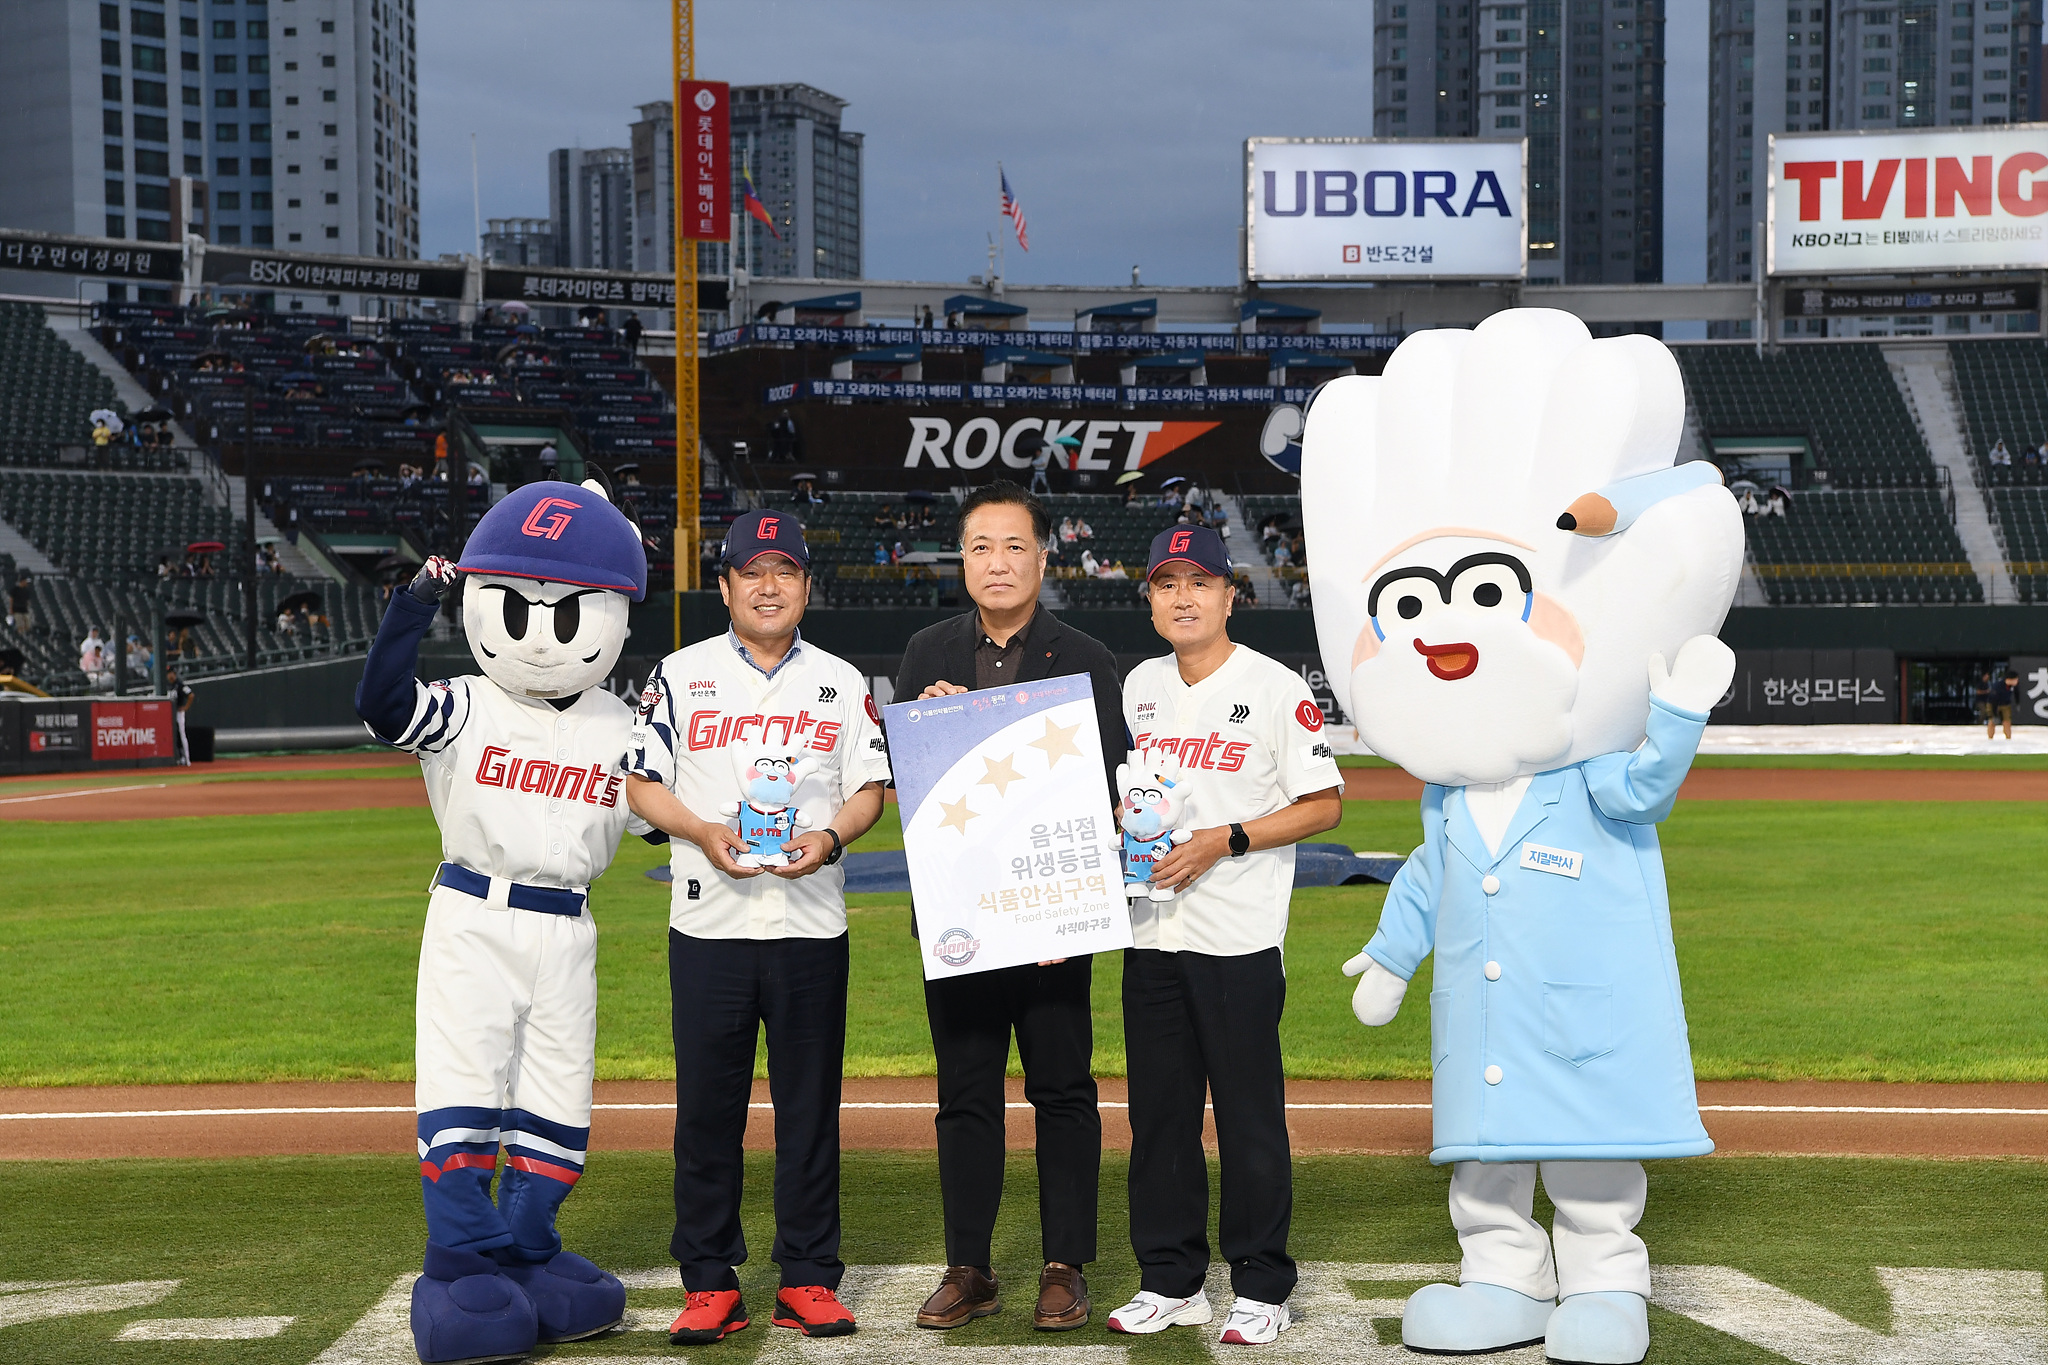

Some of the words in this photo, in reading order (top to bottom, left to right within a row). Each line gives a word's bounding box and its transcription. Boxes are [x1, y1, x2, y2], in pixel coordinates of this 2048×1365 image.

[697, 116, 714, 233] 롯데이노베이트
[1784, 151, 2048, 222] TVING
[1262, 170, 1513, 218] UBORA
[1791, 233, 1831, 248] KBO
[1834, 232, 1879, 246] 리그는
[1883, 230, 1939, 245] 티빙에서
[1942, 227, 2043, 243] 스트리밍하세요
[0, 243, 151, 274] 디우먼여성의원
[1366, 246, 1434, 264] 반도건설
[249, 259, 292, 285] BSK
[714, 329, 740, 348] ROCKET
[757, 326, 793, 341] 힘좋고
[797, 328, 838, 343] 오래가는
[843, 329, 875, 343] 자동차
[880, 329, 913, 344] 배터리
[921, 330, 953, 344] 힘좋고
[957, 331, 1000, 345] 오래가는
[1004, 331, 1036, 346] 자동차
[1040, 332, 1073, 346] 배터리
[1079, 334, 1113, 348] 힘좋고
[1117, 334, 1161, 349] 오래가는
[1164, 335, 1198, 349] 자동차
[1201, 335, 1234, 349] 배터리
[813, 381, 845, 395] 힘좋고
[848, 383, 890, 397] 오래가는
[894, 383, 926, 397] 자동차
[929, 384, 961, 398] 배터리
[903, 416, 1164, 471] ROCKET
[521, 496, 583, 541] G
[757, 516, 780, 541] G
[1168, 530, 1194, 554] G
[688, 680, 717, 690] BNK
[689, 690, 717, 698] 부산은행
[1763, 677, 1886, 706] 한성모터스
[1137, 701, 1157, 712] BNK
[475, 744, 625, 810] Giants
[1029, 816, 1098, 849] 음식점
[1011, 844, 1102, 880] 위생등급
[1528, 850, 1574, 870] 지킬박사
[977, 873, 1107, 914] 식품안심구역
[1014, 911, 1042, 924] Food
[1044, 905, 1080, 920] Safety
[1082, 902, 1110, 913] Zone
[933, 939, 981, 957] Giants
